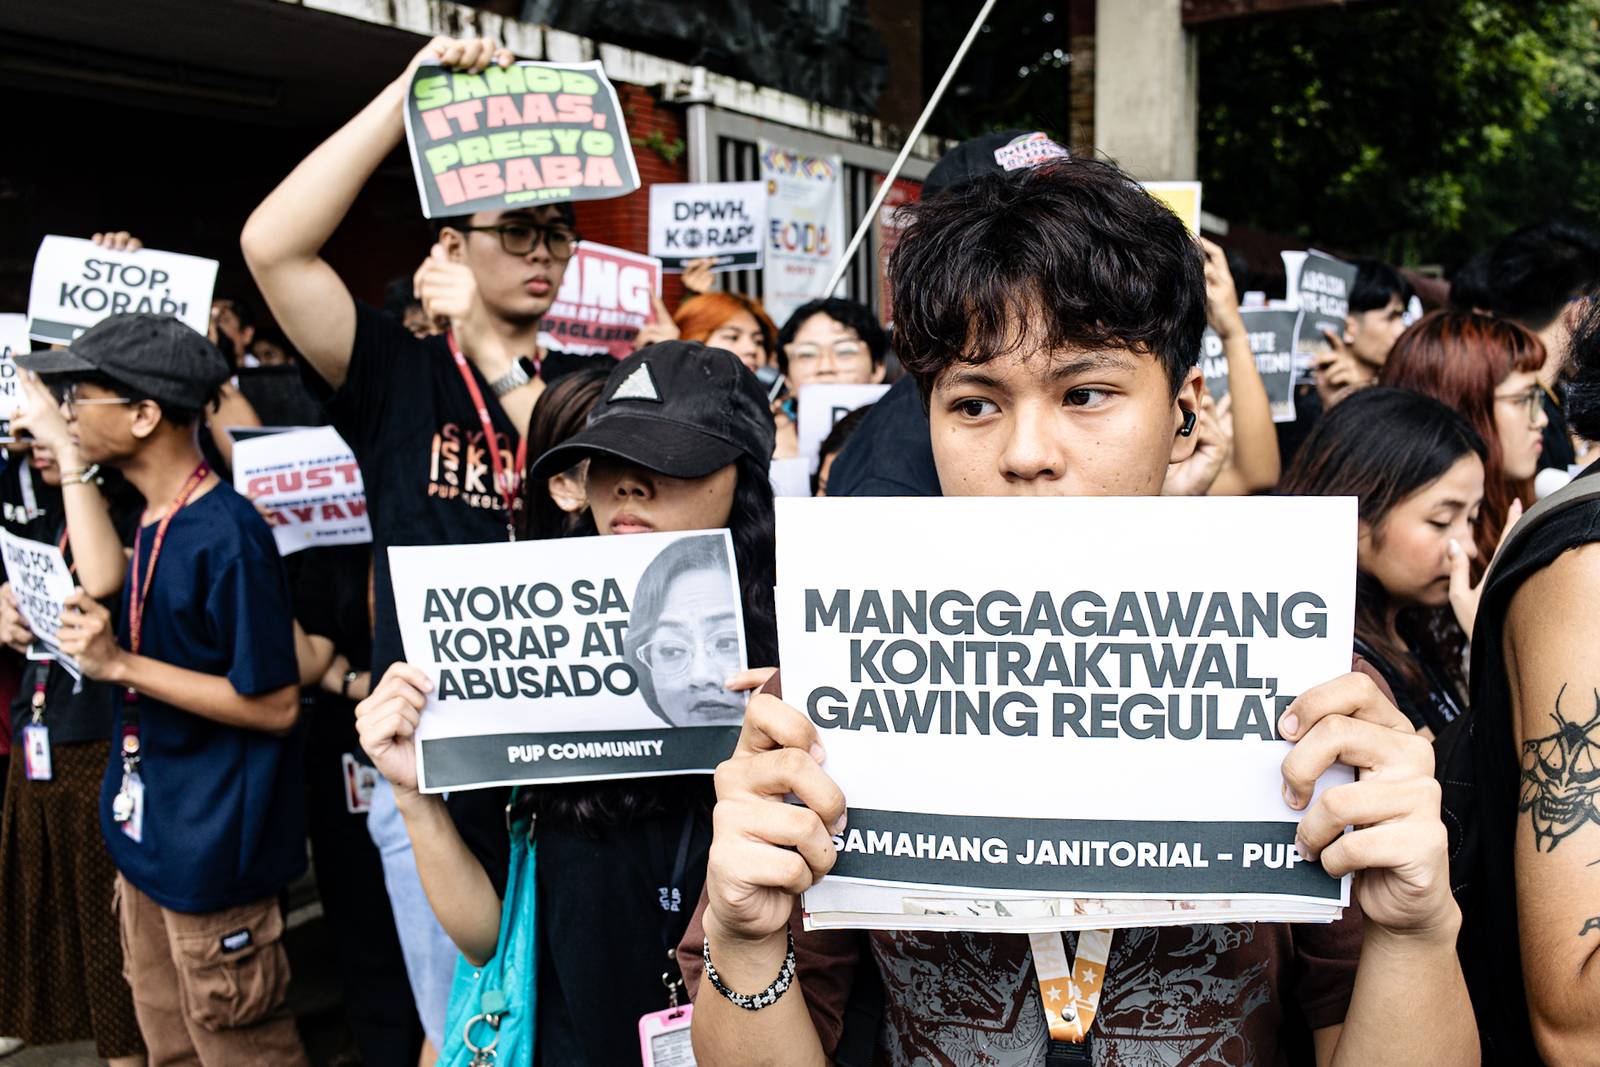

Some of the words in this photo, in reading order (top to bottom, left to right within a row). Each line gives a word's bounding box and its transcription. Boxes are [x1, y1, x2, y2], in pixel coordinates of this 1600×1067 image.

[414, 65, 599, 111] SAHOD
[421, 93, 607, 141] ITAAS,
[425, 129, 615, 175] PRESYO
[435, 156, 623, 206] IBABA
[82, 258, 171, 299] STOP,
[422, 581, 563, 623] AYOKO
[573, 577, 631, 616] SA
[804, 588, 1329, 639] MANGGAGAWANG
[429, 624, 570, 663] KORAP
[581, 619, 630, 658] AT
[437, 661, 640, 701] ABUSADO
[849, 638, 1279, 699] KONTRAKTWAL,
[806, 686, 1039, 737] GAWING
[508, 745, 545, 763] PUP
[548, 740, 664, 762] COMMUNITY
[832, 828, 1009, 864] SAMAHANG
[1016, 839, 1209, 869] JANITORIAL
[1242, 843, 1304, 869] PUP
